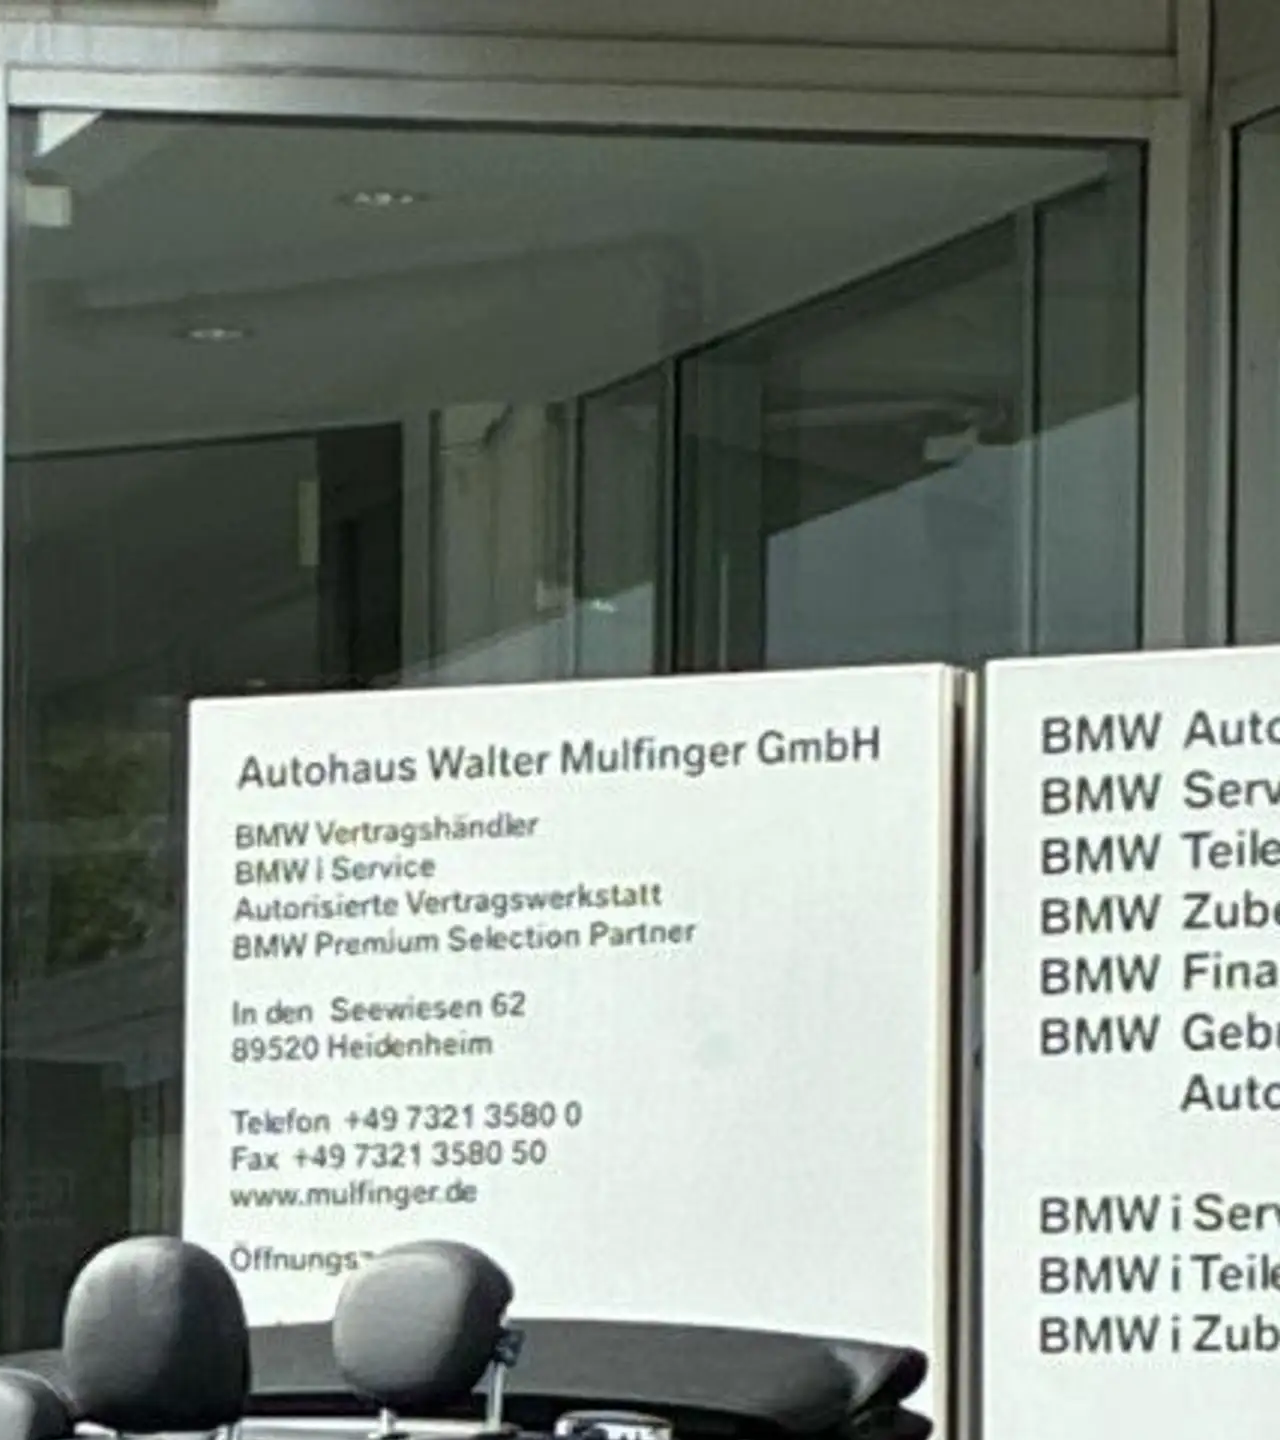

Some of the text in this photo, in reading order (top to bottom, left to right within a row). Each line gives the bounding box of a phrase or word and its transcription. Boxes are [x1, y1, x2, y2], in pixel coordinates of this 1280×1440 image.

[1042, 712, 1163, 755] BMW
[237, 725, 881, 789] Autohaus Walter Mulfinger GmbH
[1041, 773, 1163, 815] BMW
[236, 811, 540, 850] BMW Vertragshändler
[235, 855, 436, 886] BMW i Service
[1041, 829, 1280, 875] BMW Teile
[233, 883, 662, 922] Autorisierte Vertragswerkstatt
[1041, 890, 1280, 936] BMW Zub
[233, 920, 697, 961] BMW Premium Selection Partner
[1040, 951, 1279, 996] BMW Fina
[232, 991, 526, 1026] In den Seewiesen 62
[231, 1032, 493, 1063] 89520 Heidenheim
[1040, 1012, 1280, 1056] BMW Geb
[1180, 1073, 1280, 1112] Auto
[231, 1101, 582, 1135] Telefon +49 7321 3580 0
[231, 1139, 547, 1171] Fax +49 7321 3580 50
[230, 1179, 478, 1211] www.mulfinger.de
[1039, 1194, 1161, 1235] BMW
[1171, 1194, 1181, 1232] i
[230, 1241, 374, 1276] Öffnungs
[1039, 1255, 1161, 1294] BMW
[1171, 1254, 1181, 1292] i
[1039, 1314, 1280, 1355] BMW i Zub
